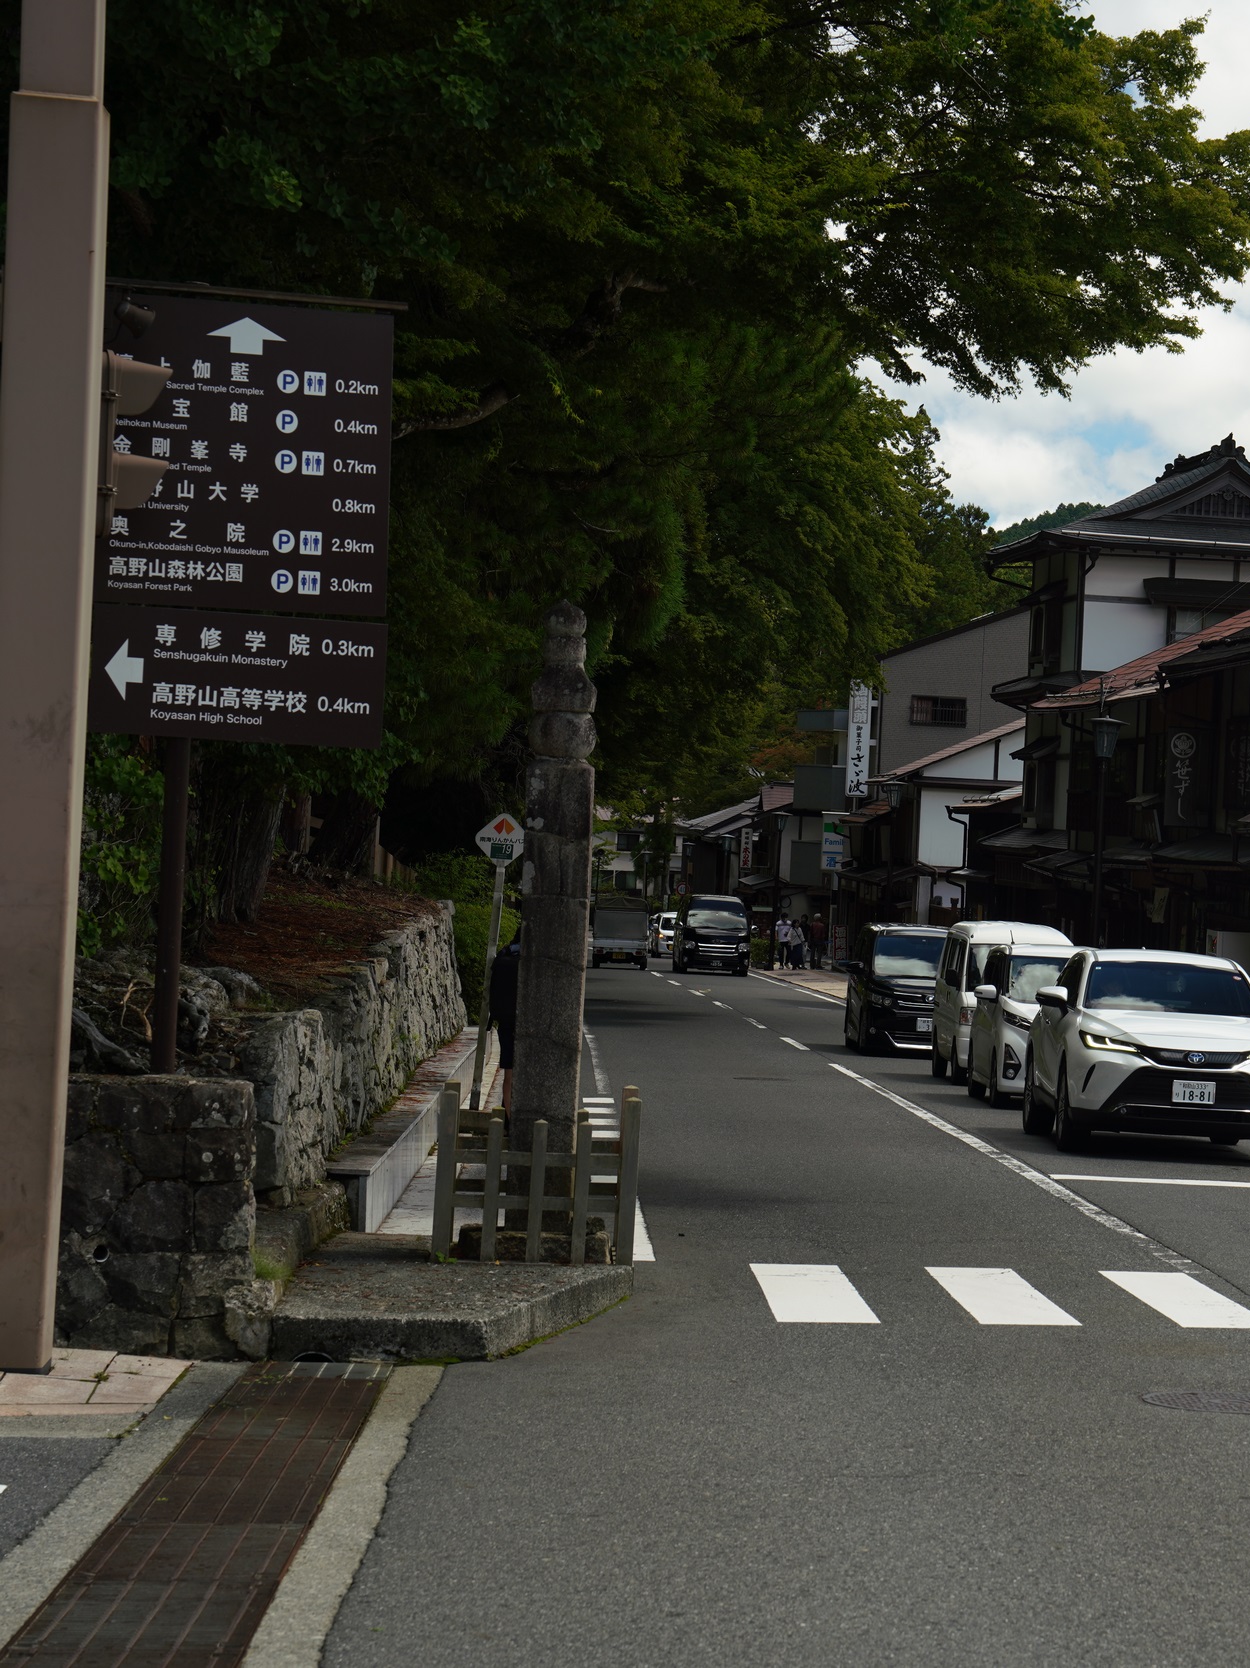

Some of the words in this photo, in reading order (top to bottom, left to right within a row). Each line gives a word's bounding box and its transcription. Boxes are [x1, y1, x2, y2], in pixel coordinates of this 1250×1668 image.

[166, 381, 195, 391] Sacred
[197, 383, 227, 394] Temple
[229, 385, 265, 396] Complex
[335, 379, 379, 396] 0.2km
[172, 398, 249, 422] 宝館
[152, 420, 188, 430] Museum
[334, 419, 378, 435] 0.4km
[112, 434, 248, 463] 金剛峯寺
[181, 463, 212, 473] Temple
[333, 459, 377, 475] 0.7km
[148, 501, 190, 513] University
[332, 498, 376, 514] 0.8km
[110, 515, 246, 543] 奥之院
[195, 545, 222, 555] Gobyo
[223, 547, 269, 556] Mausoleum
[331, 538, 375, 554] 2.9km
[108, 556, 244, 583] 高野山森林公園
[107, 580, 143, 590] Koyasan
[144, 582, 172, 591] Forest
[173, 583, 193, 592] Park
[329, 578, 373, 593] 3.0km
[155, 624, 310, 656] 専修学院
[321, 639, 374, 658] 0.3km
[153, 649, 229, 663] Senshugakuin
[231, 654, 288, 669] Monastery
[152, 682, 307, 714] 高野山高等学校
[317, 696, 370, 714] 0.4km
[150, 708, 196, 723] Koyasan
[199, 711, 224, 725] High
[226, 712, 263, 725] School
[502, 844, 512, 854] 19
[826, 856, 837, 868] 酒
[1182, 1090, 1211, 1102] 18-81
